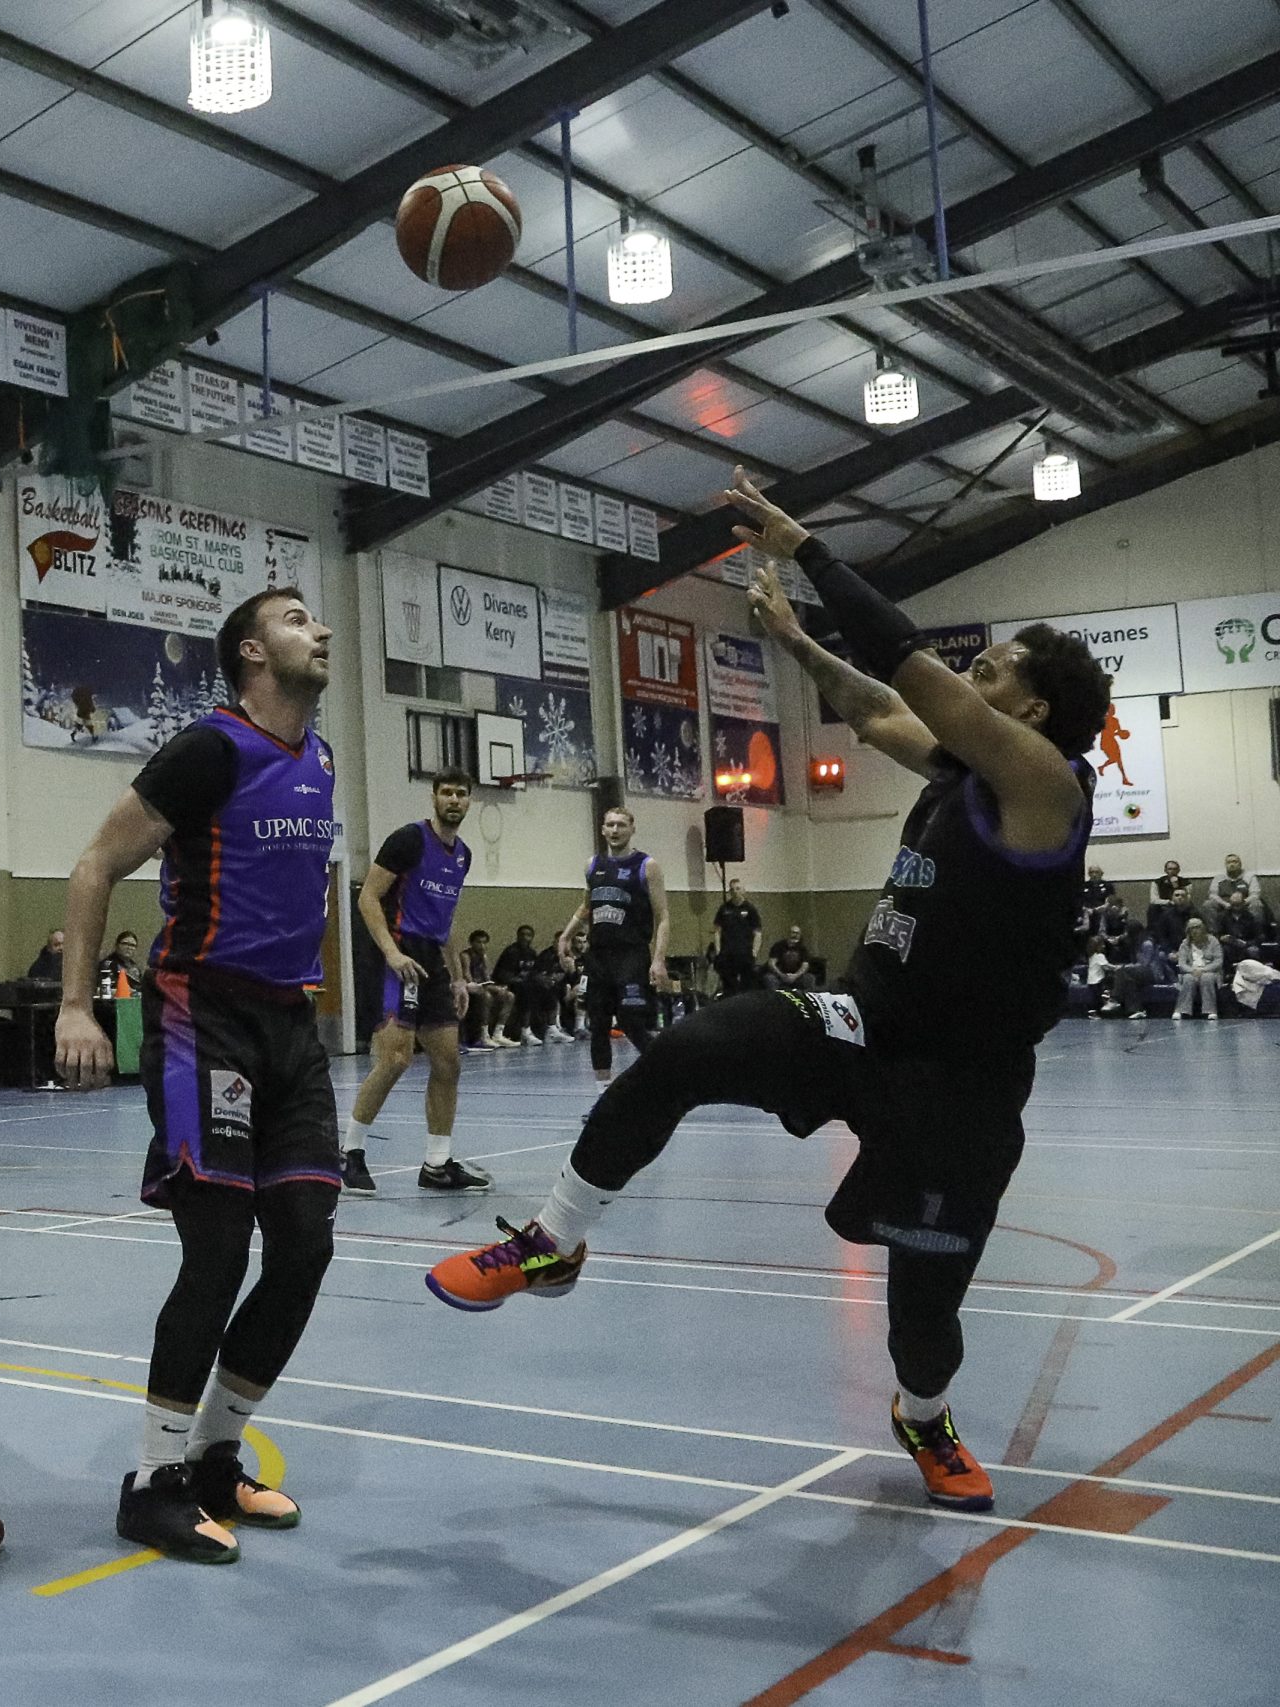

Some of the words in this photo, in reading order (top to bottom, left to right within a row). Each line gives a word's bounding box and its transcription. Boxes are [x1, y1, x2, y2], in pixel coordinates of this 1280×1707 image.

[13, 318, 54, 339] DIVISION
[36, 365, 61, 379] FAMILY
[21, 486, 101, 531] Basketball
[179, 508, 248, 541] GREETINGS
[53, 548, 97, 577] BLITZ
[149, 544, 216, 570] BASKETBALL
[217, 557, 245, 575] CLUB
[141, 589, 174, 606] MAJOR
[175, 595, 223, 614] SPONSORS
[483, 592, 528, 620] Divanes
[484, 620, 516, 650] Kerry
[252, 817, 313, 840] UPMC
